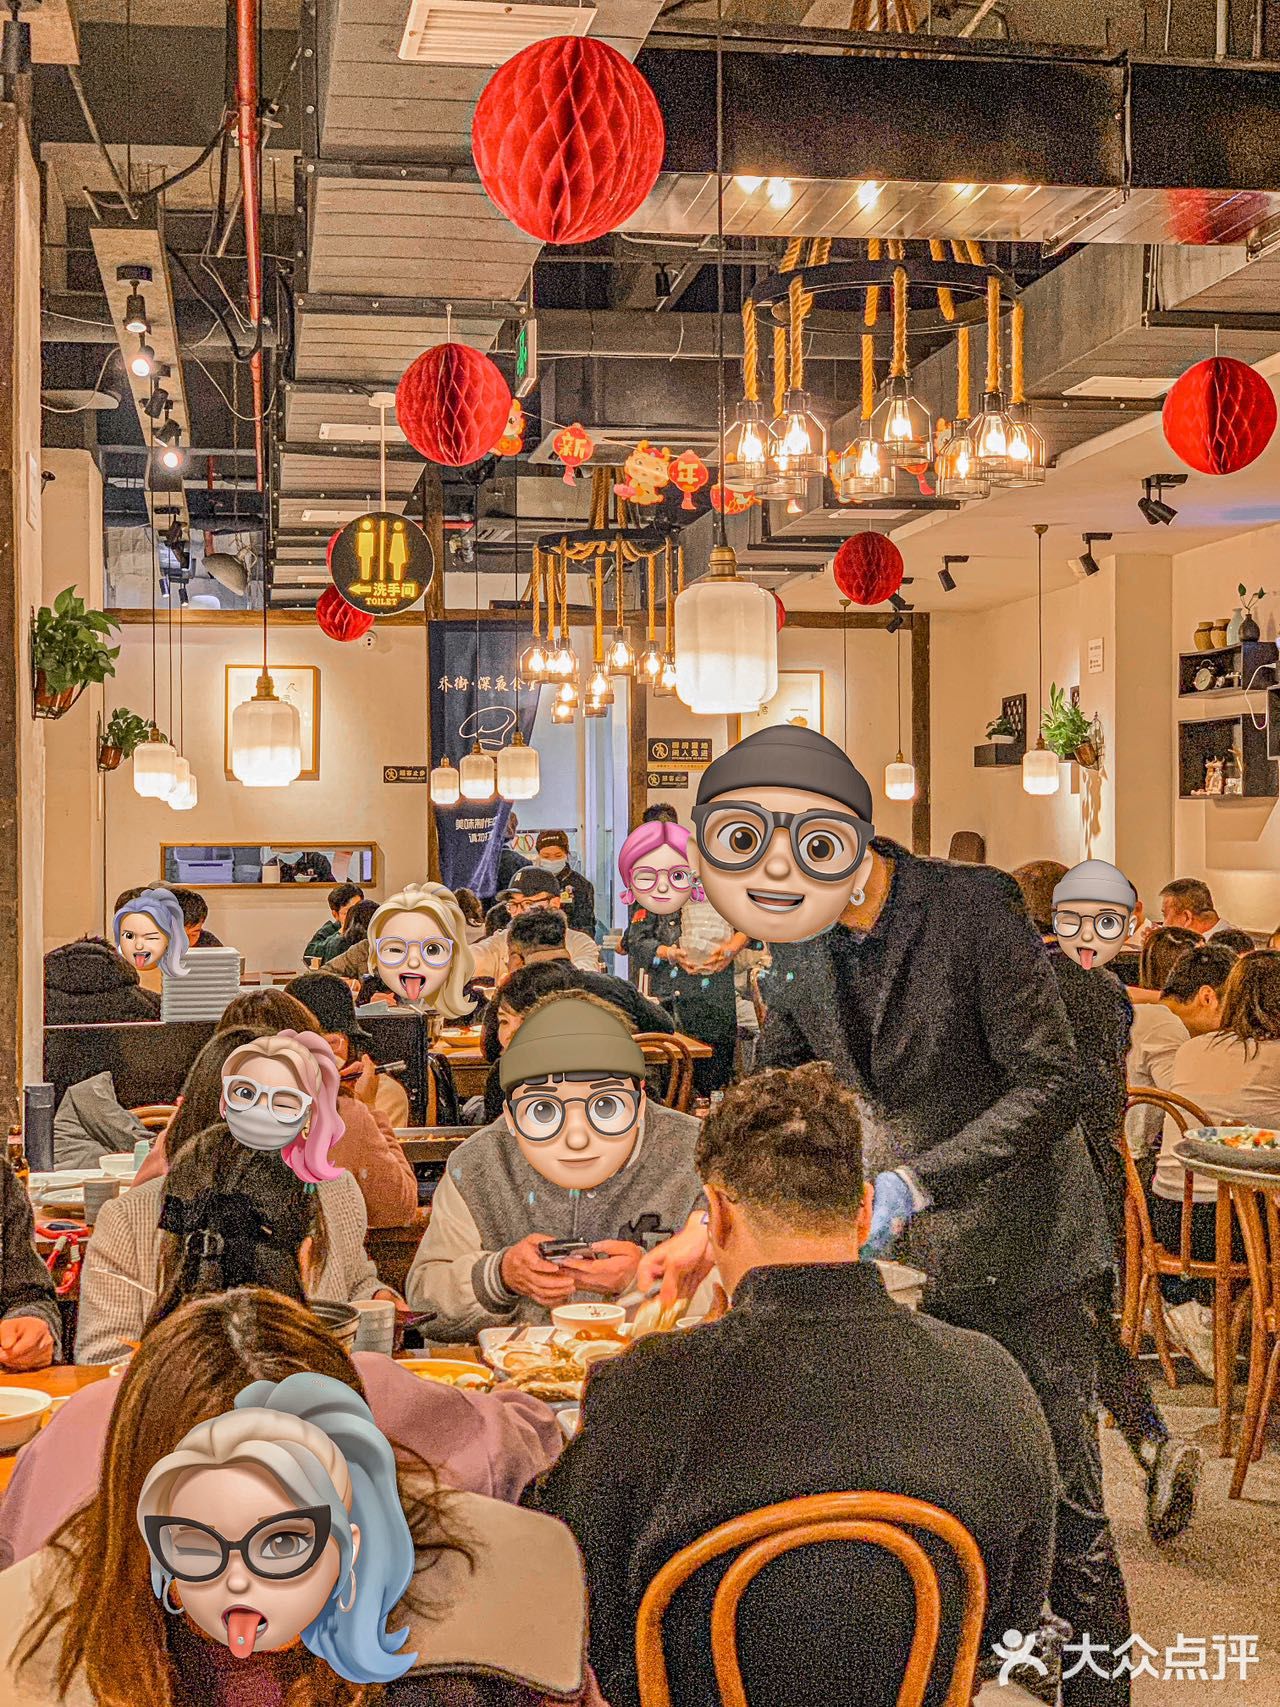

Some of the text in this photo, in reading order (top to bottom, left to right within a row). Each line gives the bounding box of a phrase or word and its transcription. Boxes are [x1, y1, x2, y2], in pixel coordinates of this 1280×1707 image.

[559, 431, 587, 459] 新
[677, 461, 699, 484] 年
[373, 582, 415, 597] 洗手间
[365, 597, 398, 606] TOILET
[455, 816, 498, 830] 美味制作
